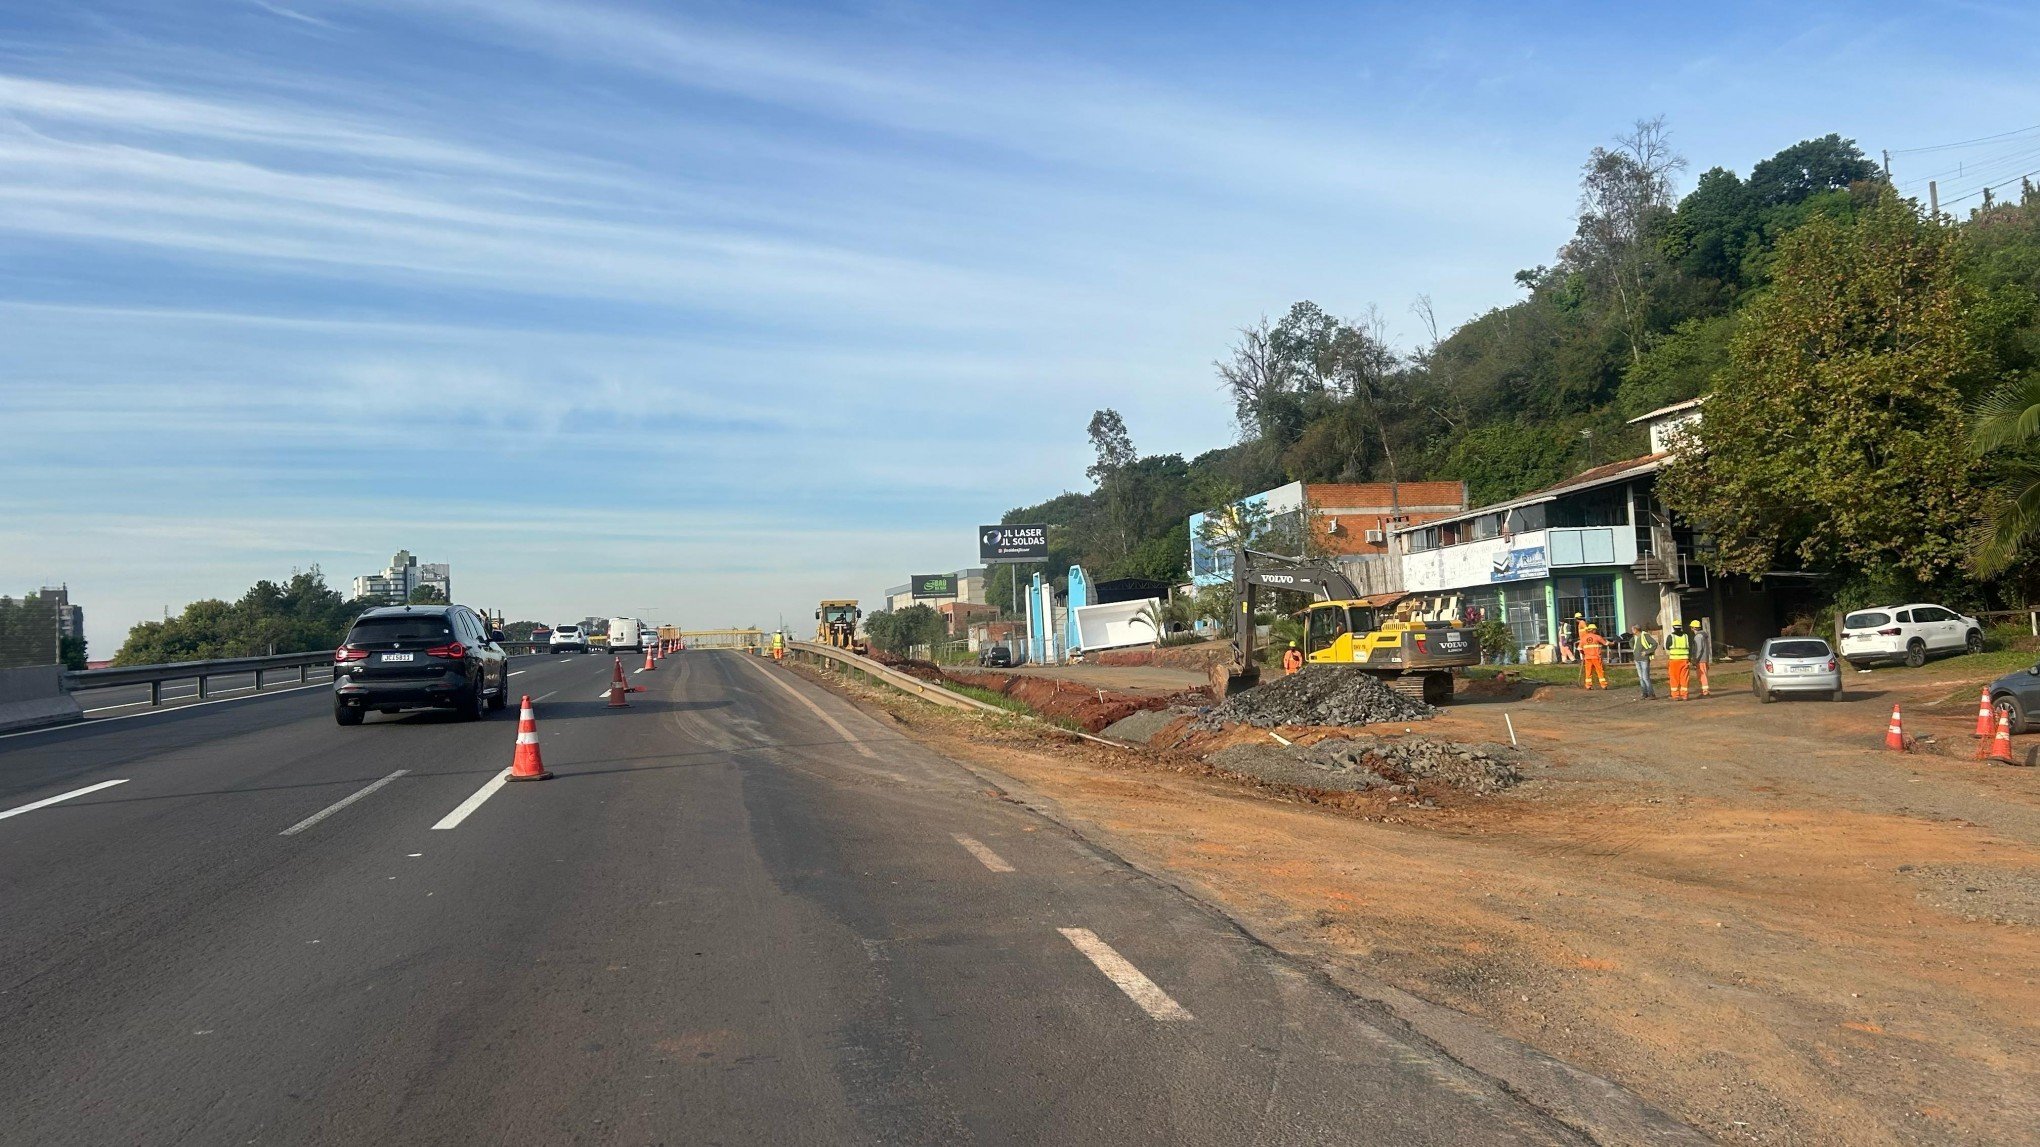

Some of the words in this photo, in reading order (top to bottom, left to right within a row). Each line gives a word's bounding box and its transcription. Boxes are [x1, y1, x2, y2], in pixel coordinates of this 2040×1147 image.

[1014, 528, 1042, 536] LASER
[1001, 538, 1010, 546] JL
[1012, 537, 1045, 545] SOLDAS
[1261, 574, 1294, 583] VOLVO
